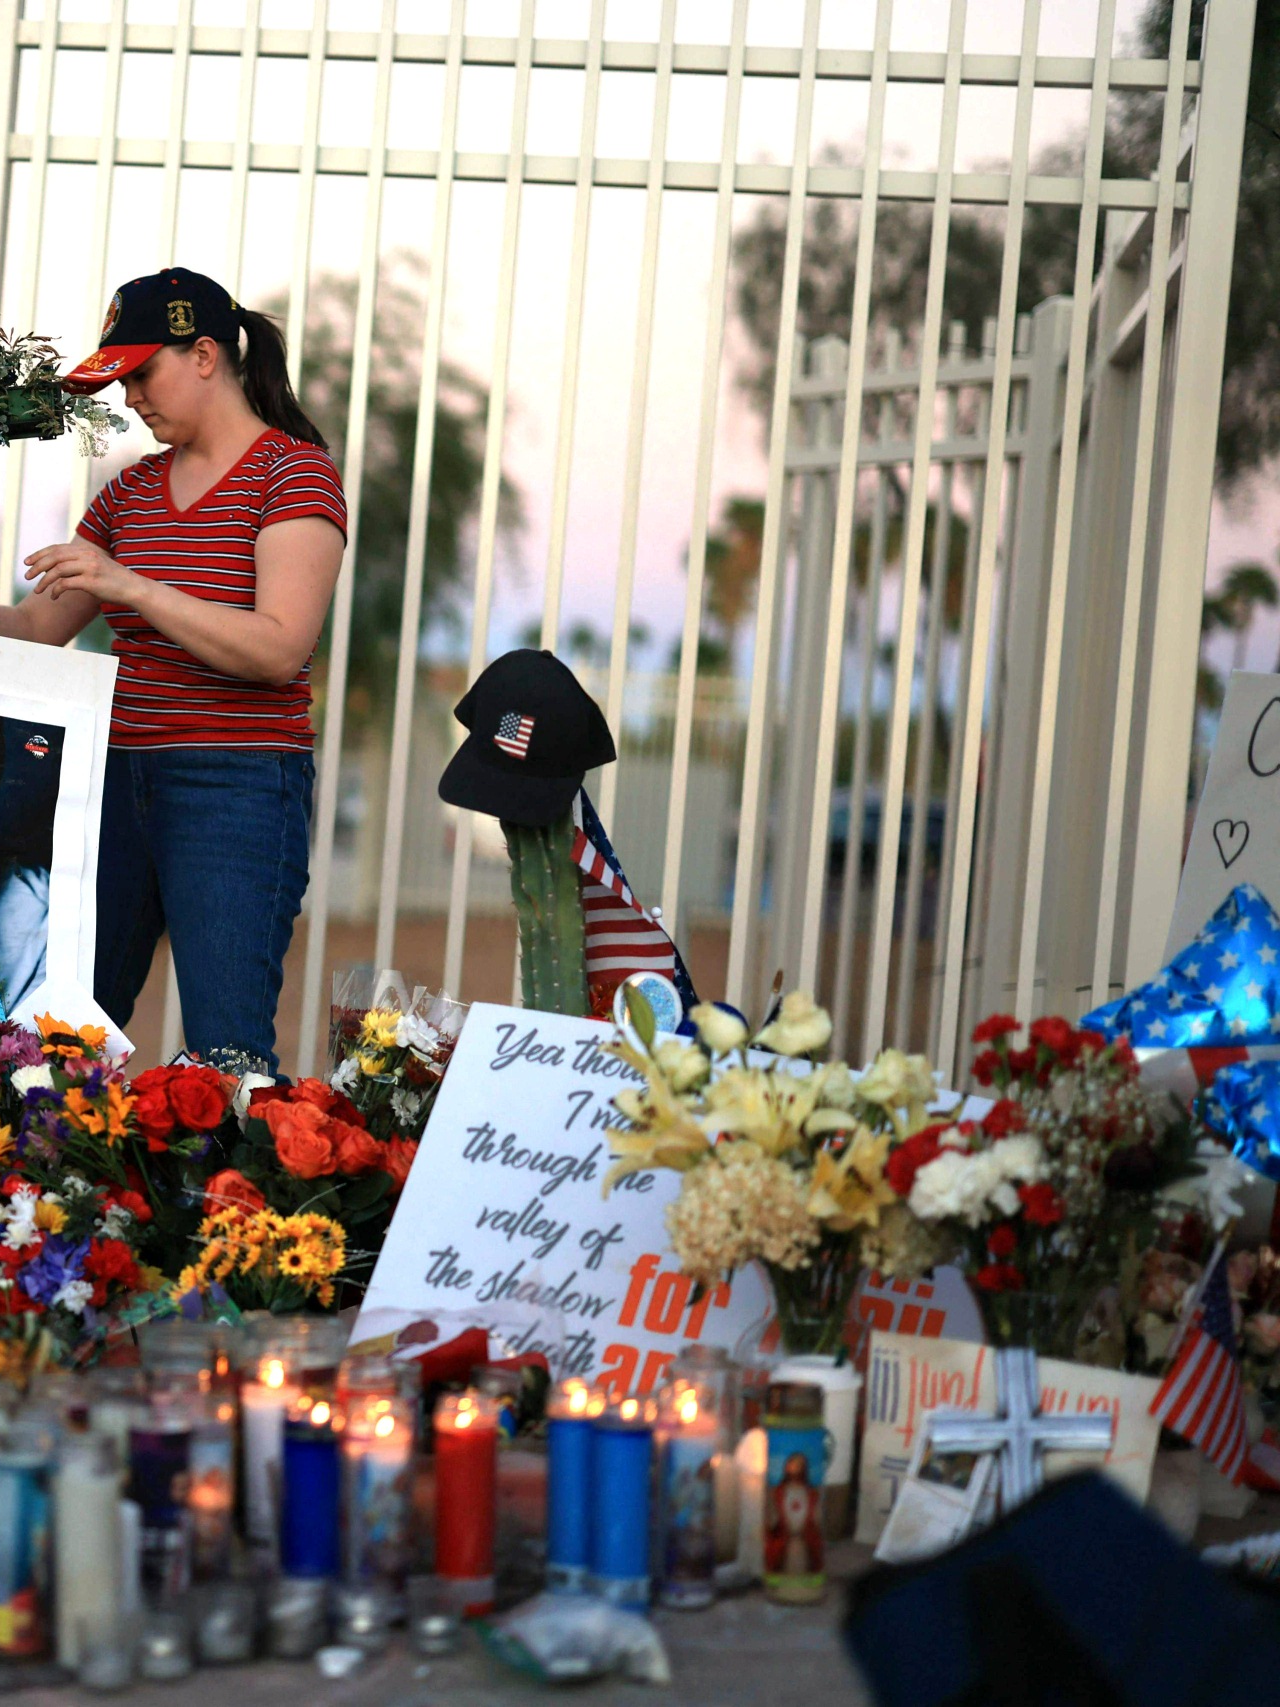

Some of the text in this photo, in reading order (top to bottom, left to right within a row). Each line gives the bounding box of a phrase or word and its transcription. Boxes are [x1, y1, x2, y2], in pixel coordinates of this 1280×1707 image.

[490, 1023, 650, 1090] Yea thou
[462, 1122, 603, 1196] through
[476, 1197, 624, 1270] valley of
[424, 1245, 616, 1319] the shadow
[617, 1253, 732, 1340] for
